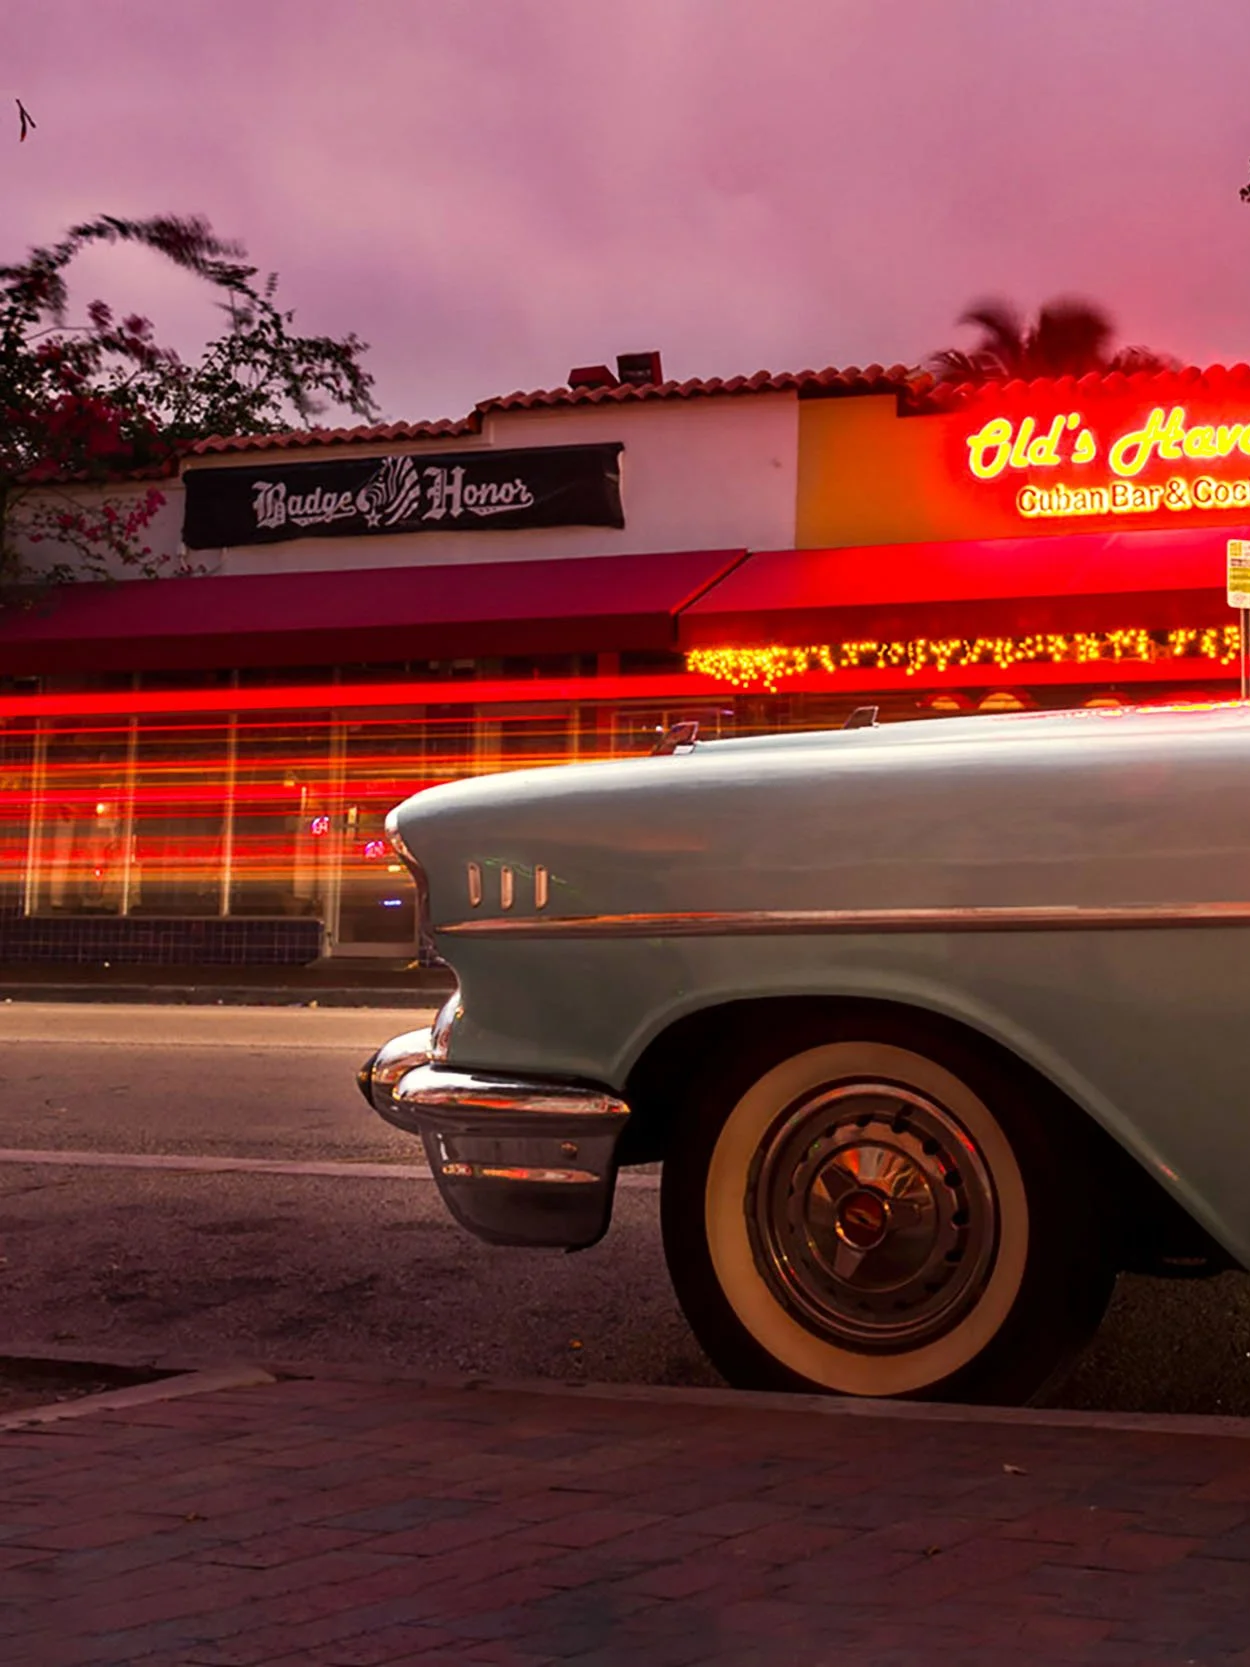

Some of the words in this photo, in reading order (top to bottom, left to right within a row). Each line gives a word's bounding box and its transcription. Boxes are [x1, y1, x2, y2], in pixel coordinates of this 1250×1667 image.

[967, 413, 1096, 479] Old's
[252, 481, 358, 529] Badge
[421, 466, 534, 521] Honor
[1017, 485, 1107, 516] Cuban
[1111, 481, 1162, 510] Bar
[1165, 478, 1187, 506] &
